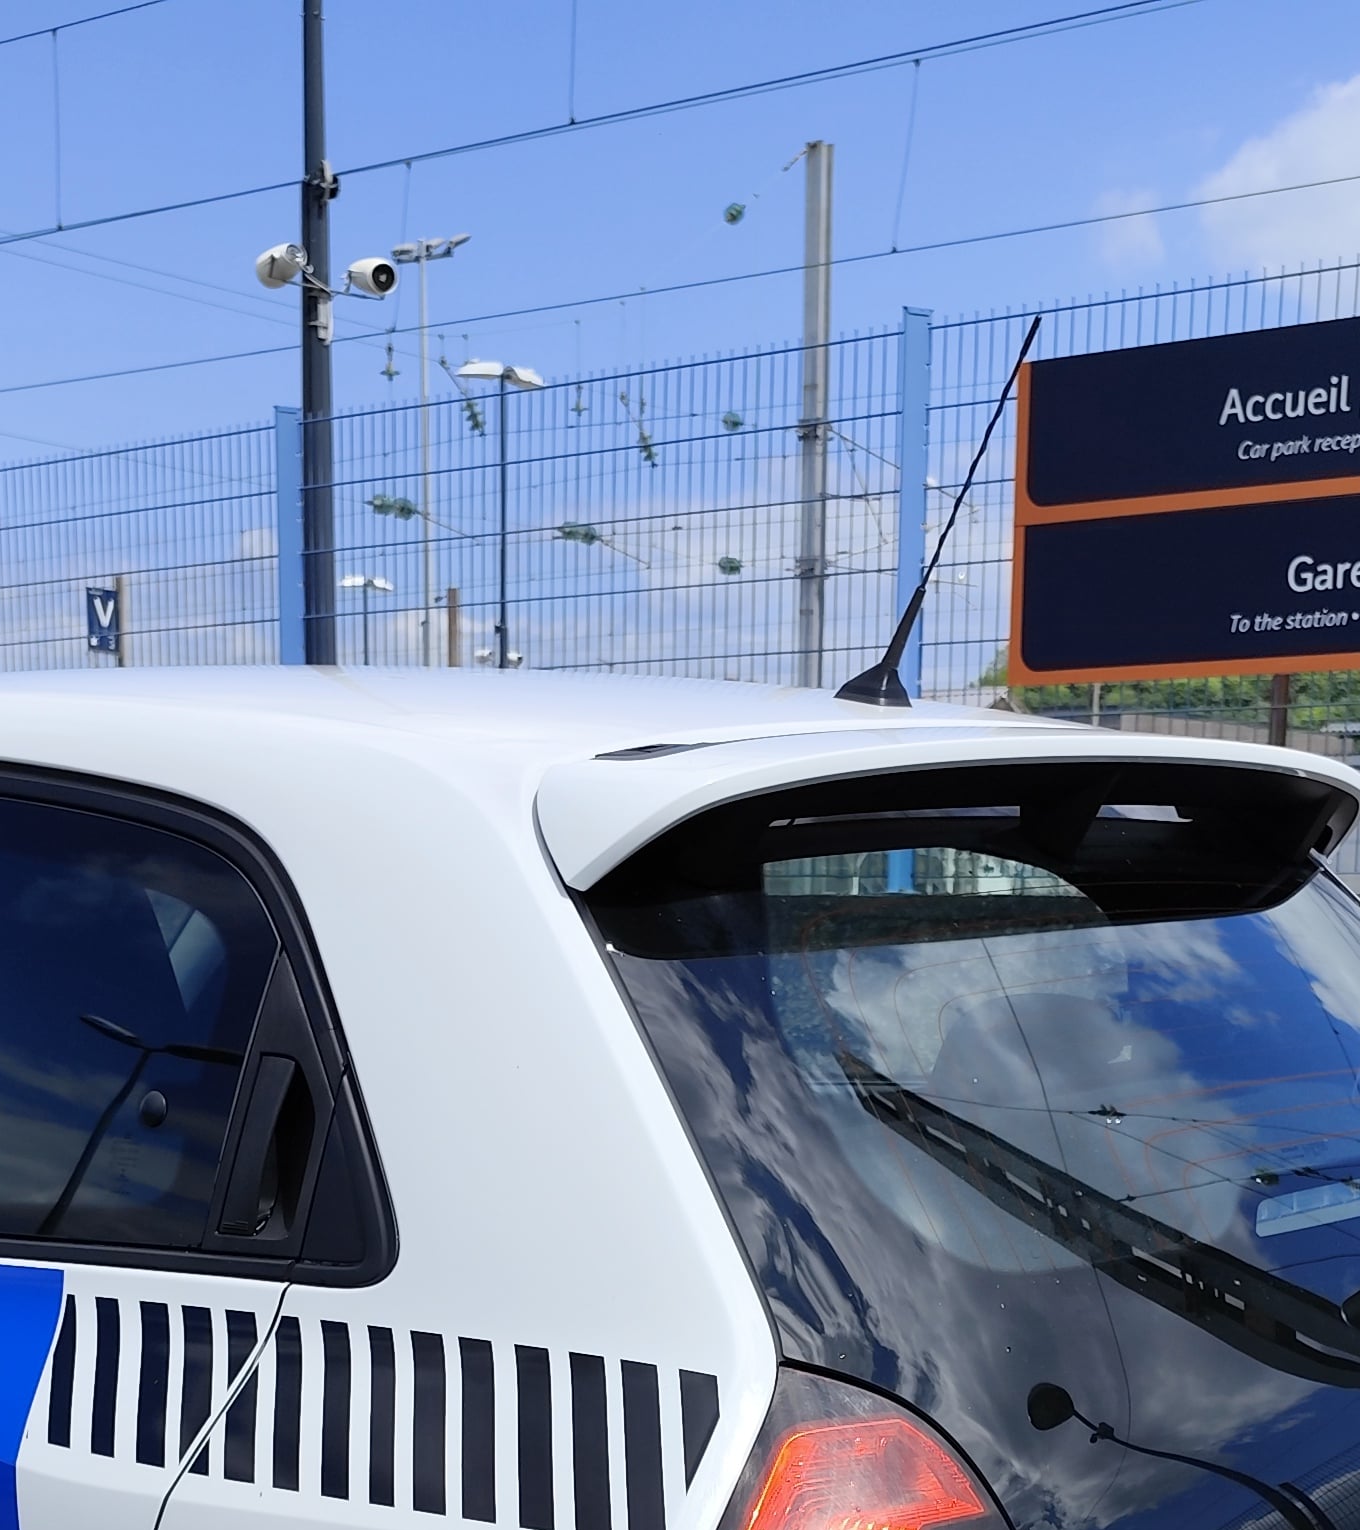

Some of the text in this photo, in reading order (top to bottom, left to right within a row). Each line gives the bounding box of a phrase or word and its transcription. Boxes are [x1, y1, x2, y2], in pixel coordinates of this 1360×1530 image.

[1219, 374, 1351, 426] Accueil
[1238, 439, 1270, 460] Car
[1271, 436, 1310, 462] park
[93, 596, 115, 628] V
[1229, 615, 1250, 633] To
[1253, 611, 1281, 631] the
[1284, 608, 1348, 630] station
